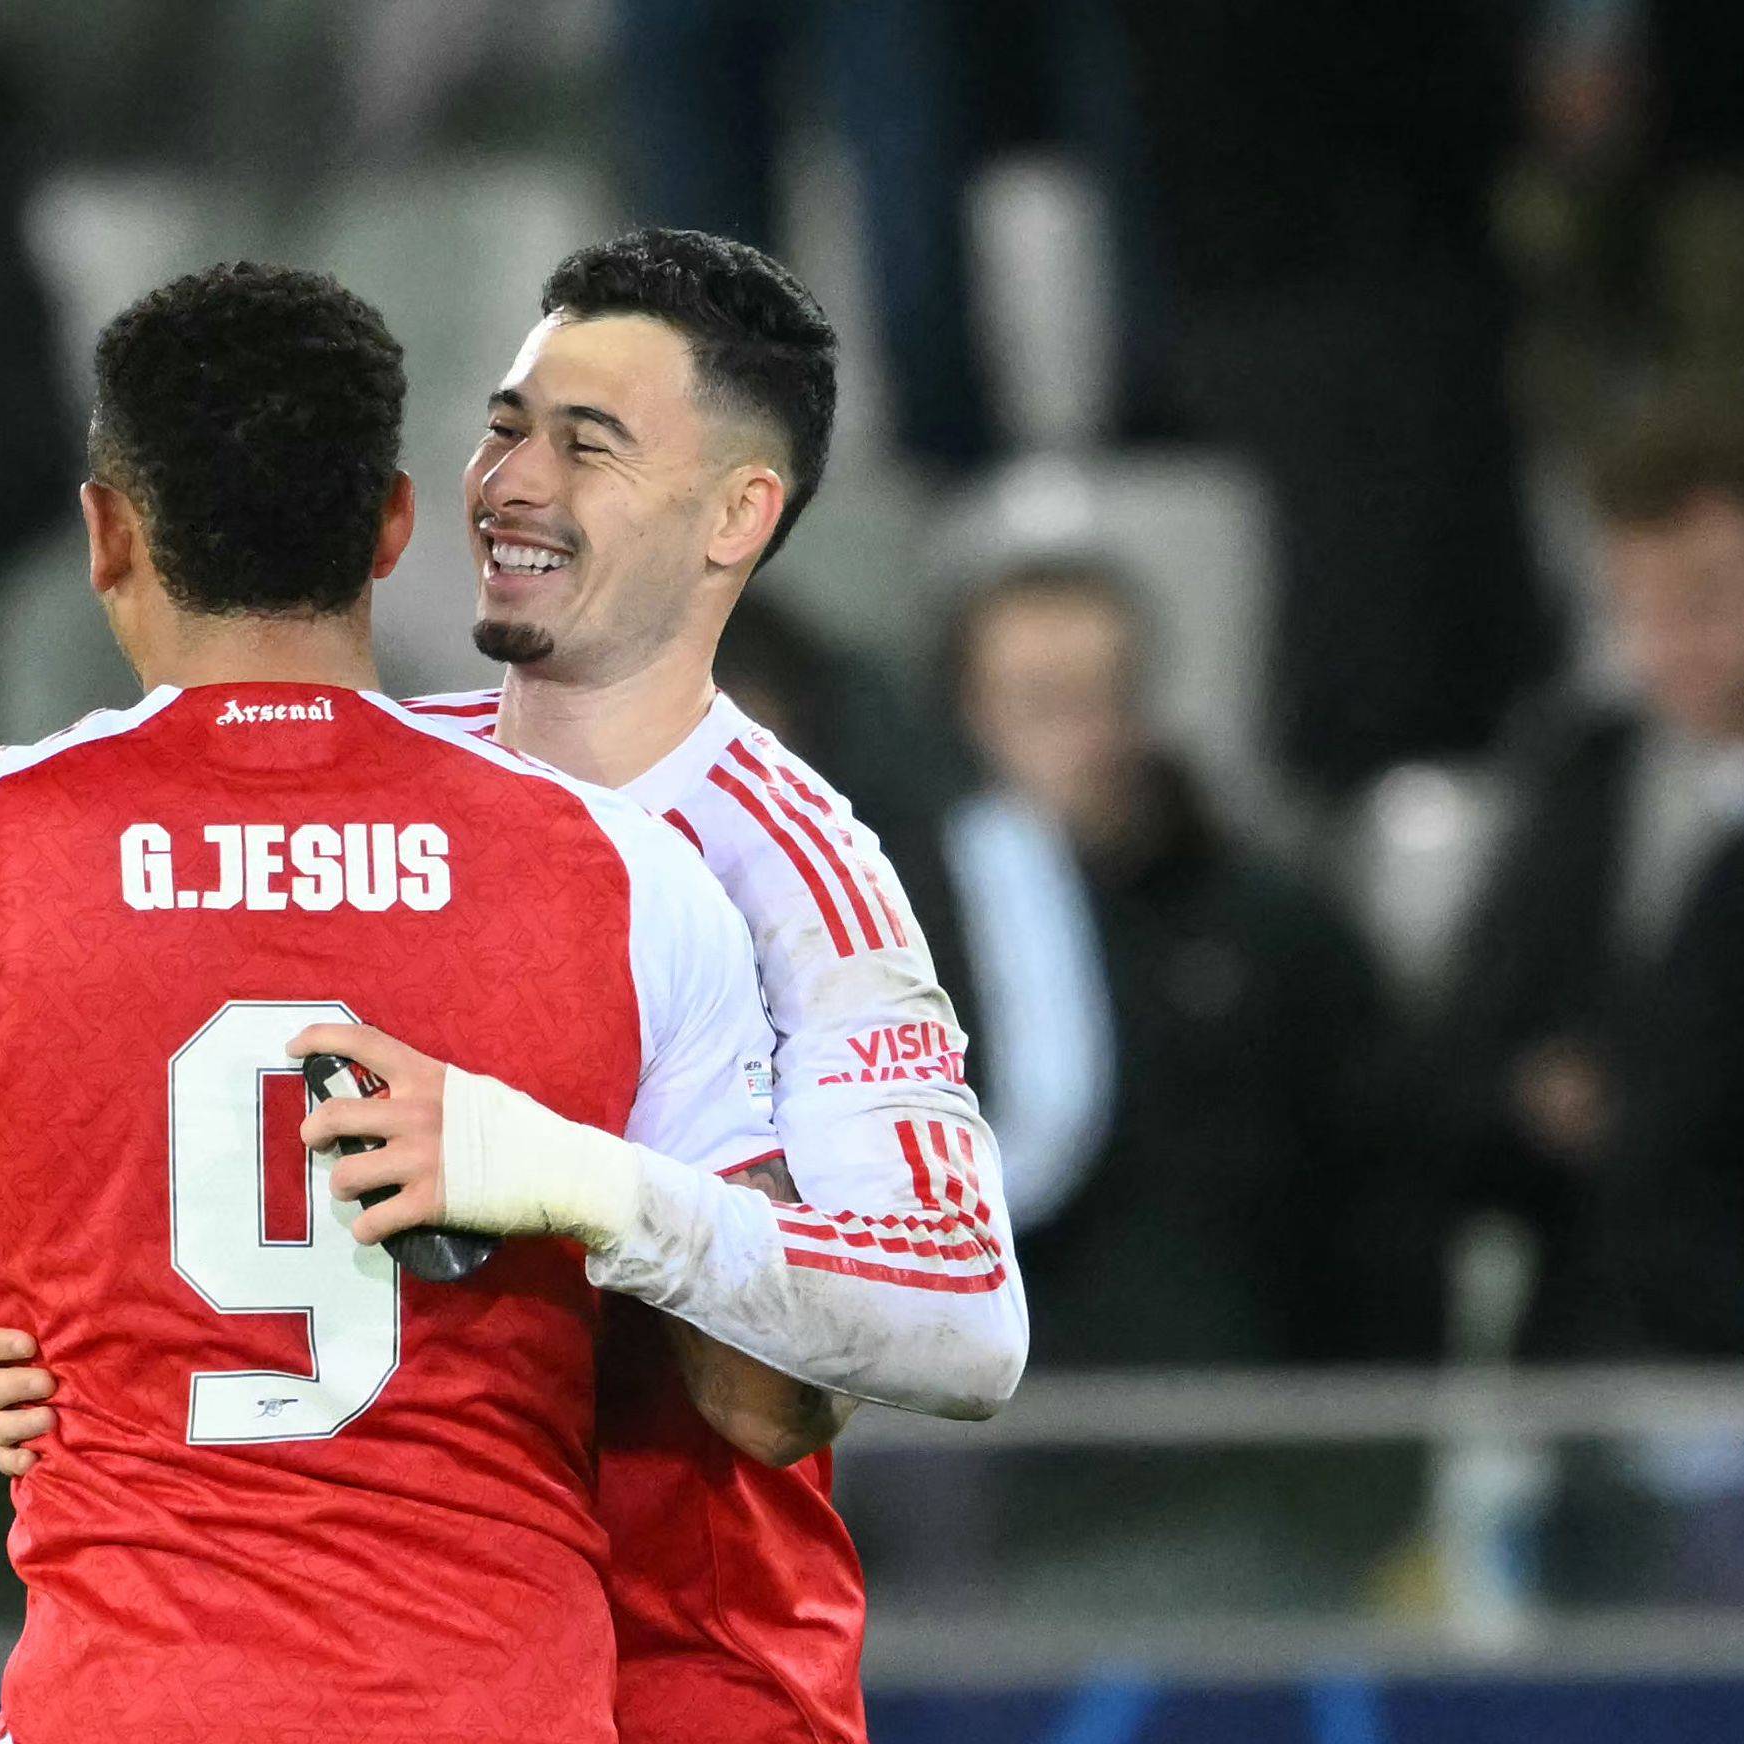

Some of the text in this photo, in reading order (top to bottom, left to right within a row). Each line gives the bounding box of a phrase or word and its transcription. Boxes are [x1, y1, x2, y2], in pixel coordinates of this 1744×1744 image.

[215, 696, 334, 726] Arsenal
[119, 823, 451, 912] G.JESUS
[846, 1020, 950, 1068] VISIT
[168, 1000, 401, 1446] 9
